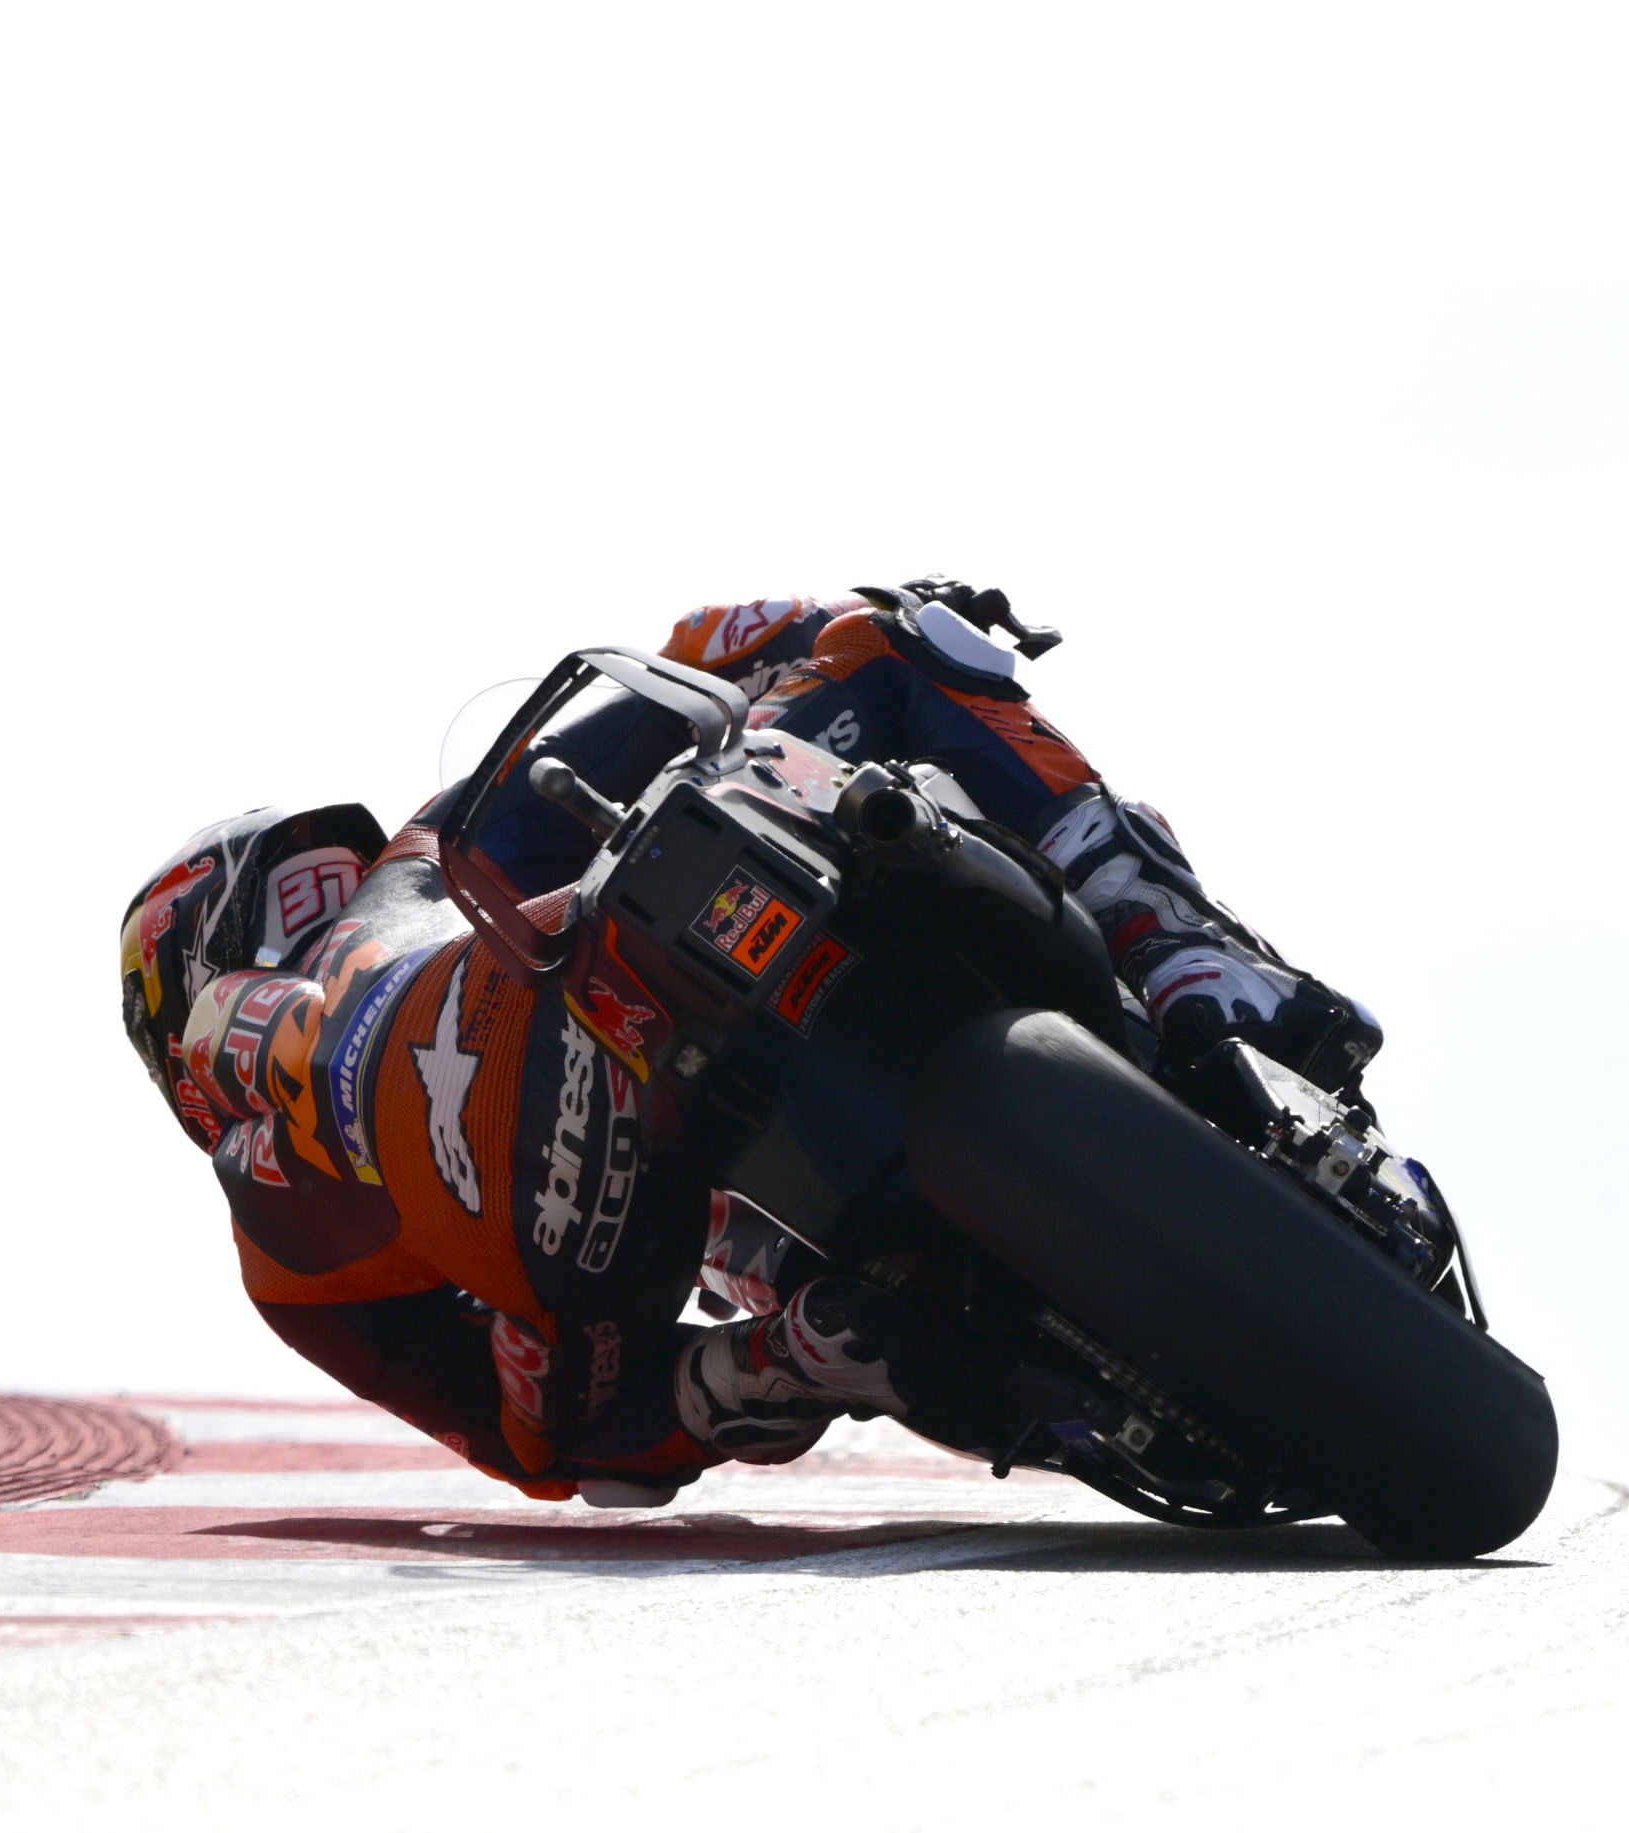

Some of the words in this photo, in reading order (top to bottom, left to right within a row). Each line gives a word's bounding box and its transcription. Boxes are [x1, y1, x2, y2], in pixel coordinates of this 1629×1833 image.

[278, 860, 362, 938] 37
[747, 911, 788, 964] KTM
[338, 960, 414, 1115] MICHELIN
[533, 1008, 596, 1257] alpinest
